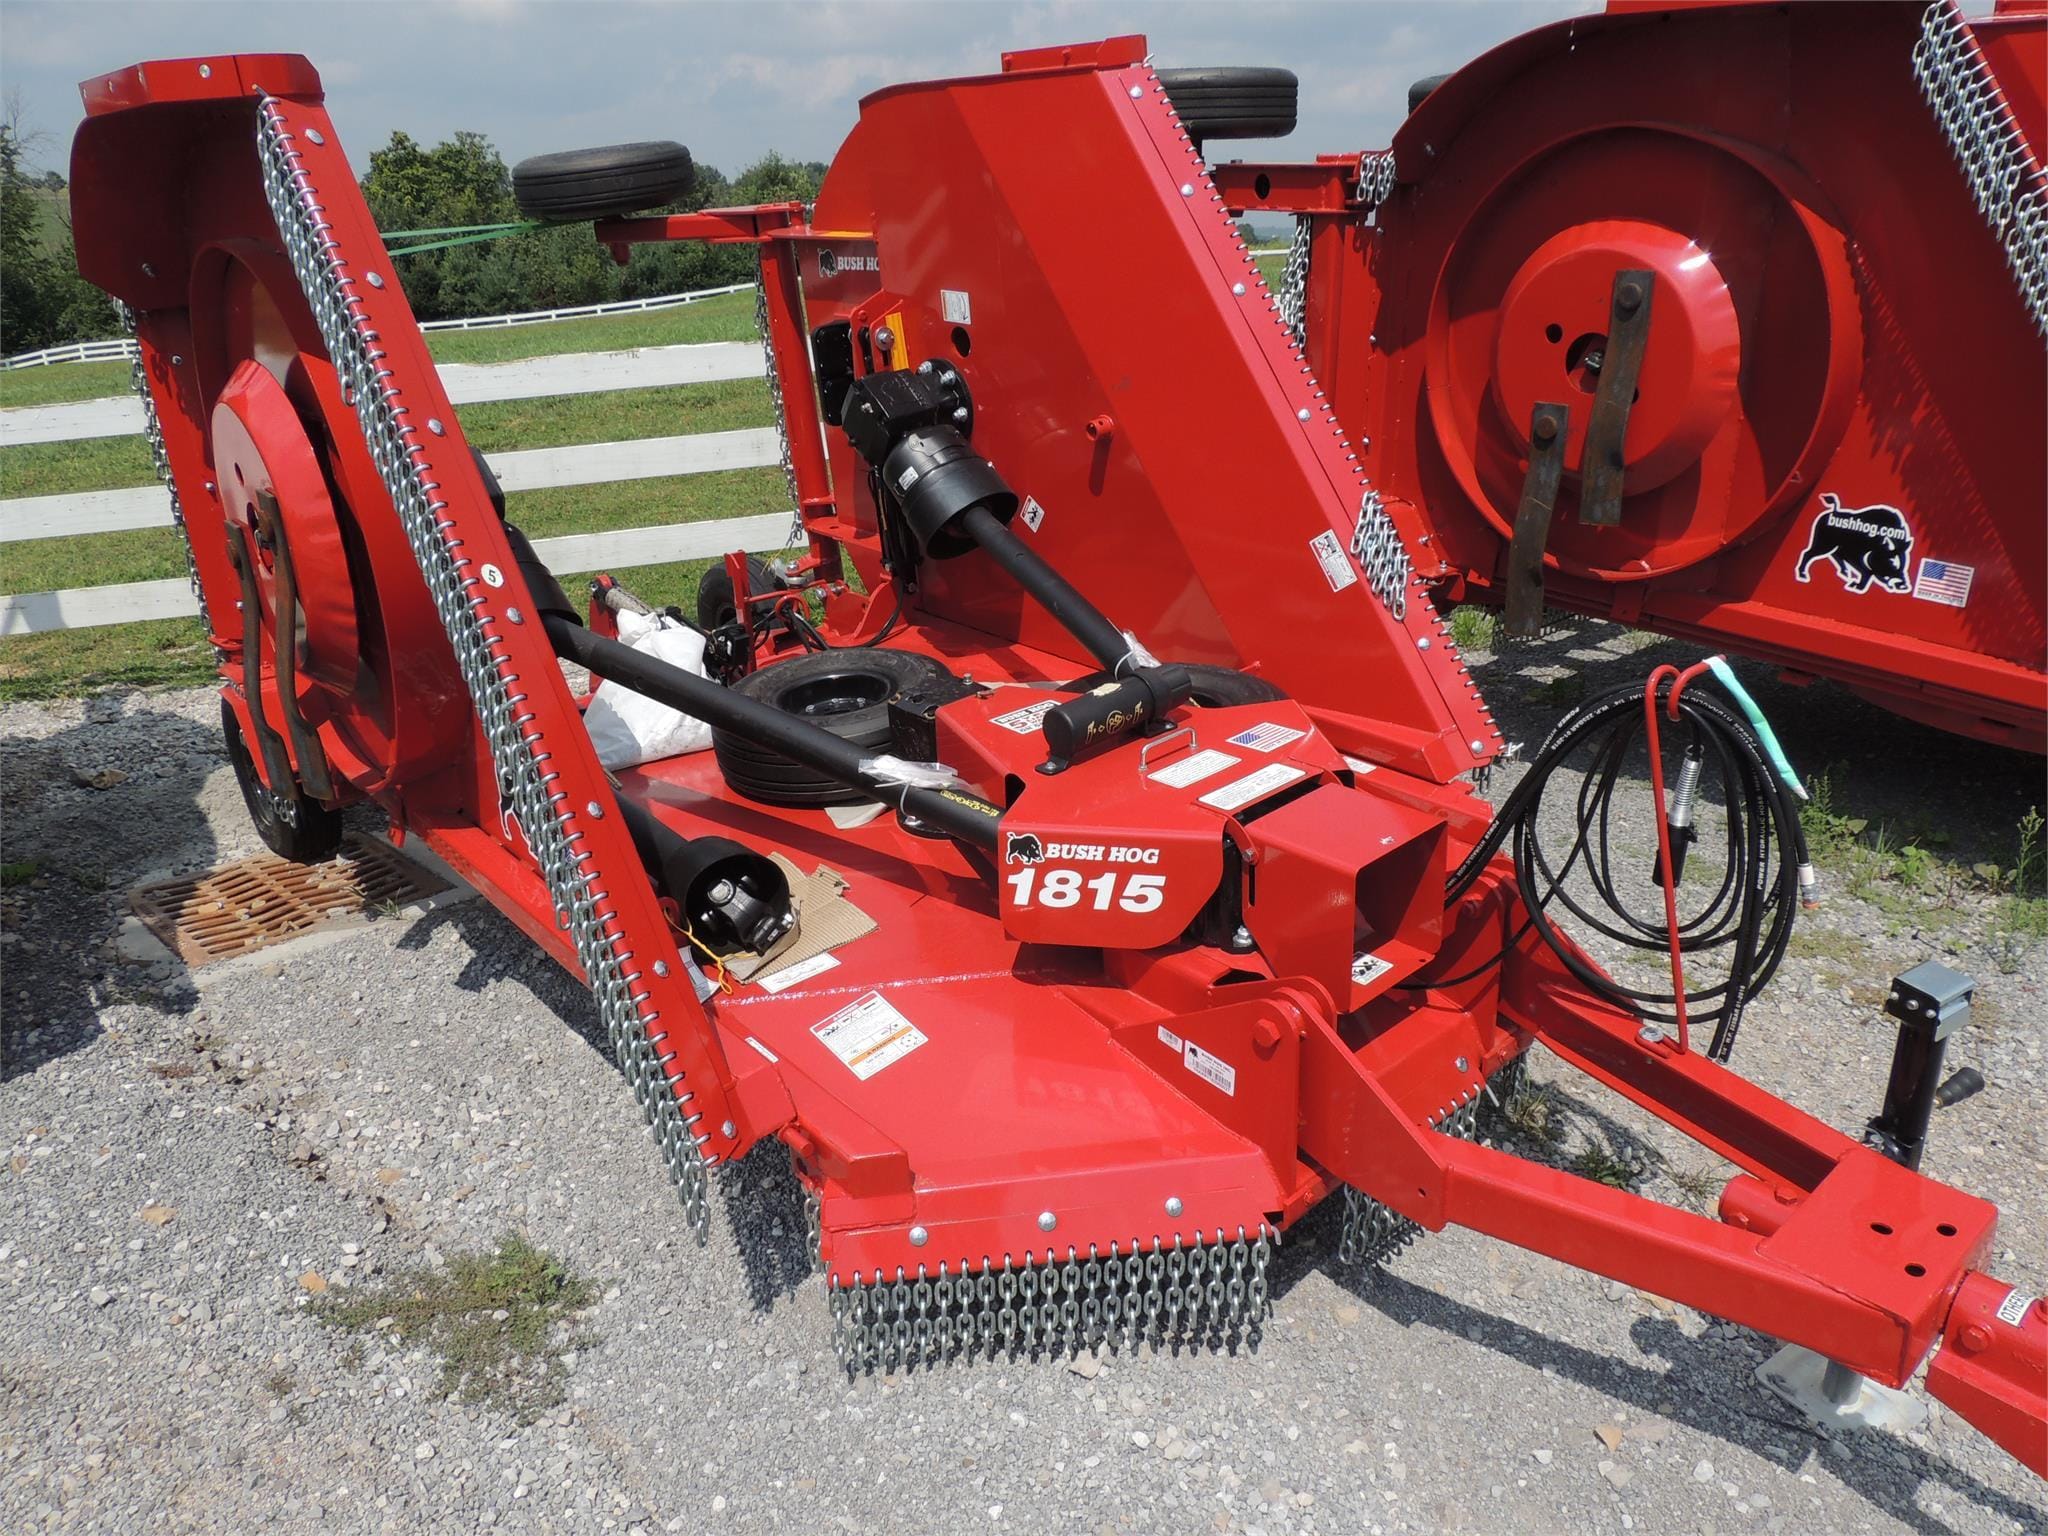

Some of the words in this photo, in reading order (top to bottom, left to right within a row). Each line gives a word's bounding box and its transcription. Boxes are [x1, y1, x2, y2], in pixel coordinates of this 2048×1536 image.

[837, 255, 865, 271] BUSH
[865, 256, 880, 271] HO
[1827, 512, 1906, 540] bushhog.com
[488, 569, 496, 583] 5
[1557, 706, 1580, 728] POWER
[1044, 843, 1106, 861] BUSH
[1107, 846, 1160, 864] HOG
[1757, 861, 1766, 890] POWER
[1007, 867, 1167, 913] 1815
